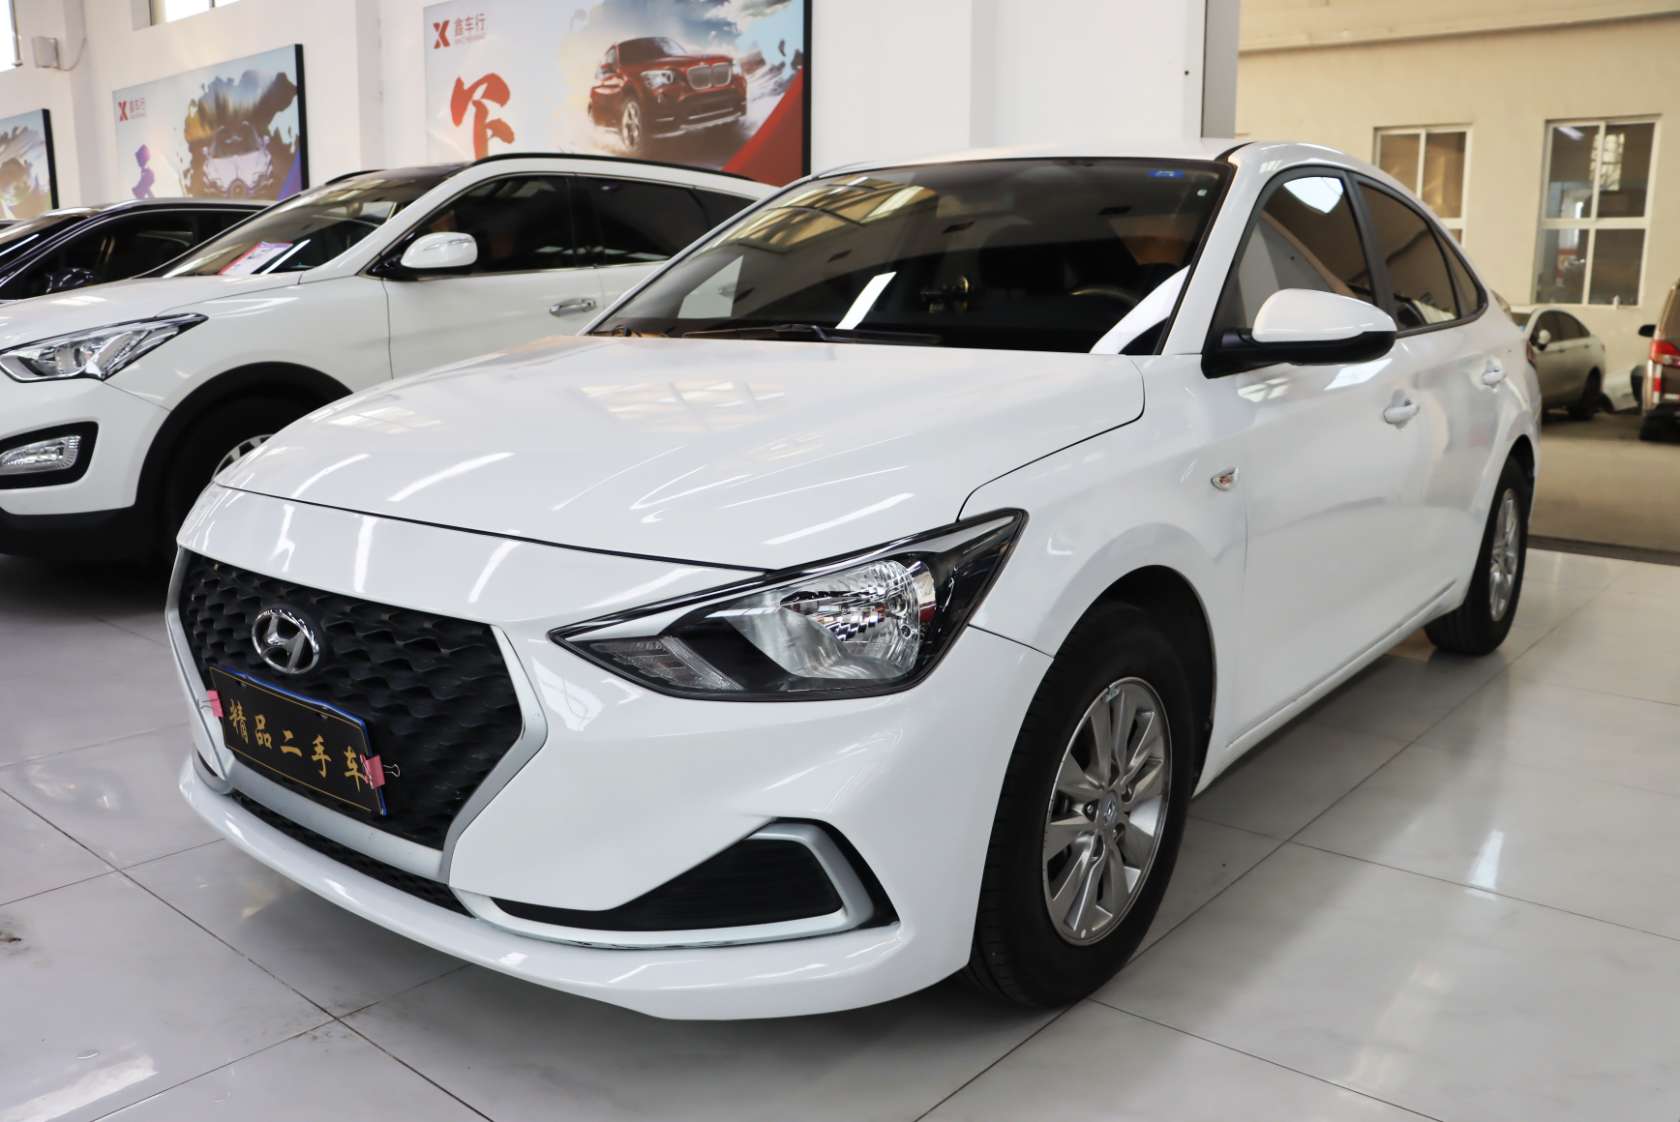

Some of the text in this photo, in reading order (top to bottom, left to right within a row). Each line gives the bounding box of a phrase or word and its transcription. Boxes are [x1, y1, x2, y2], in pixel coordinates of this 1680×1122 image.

[228, 697, 366, 792] 精品二手车
